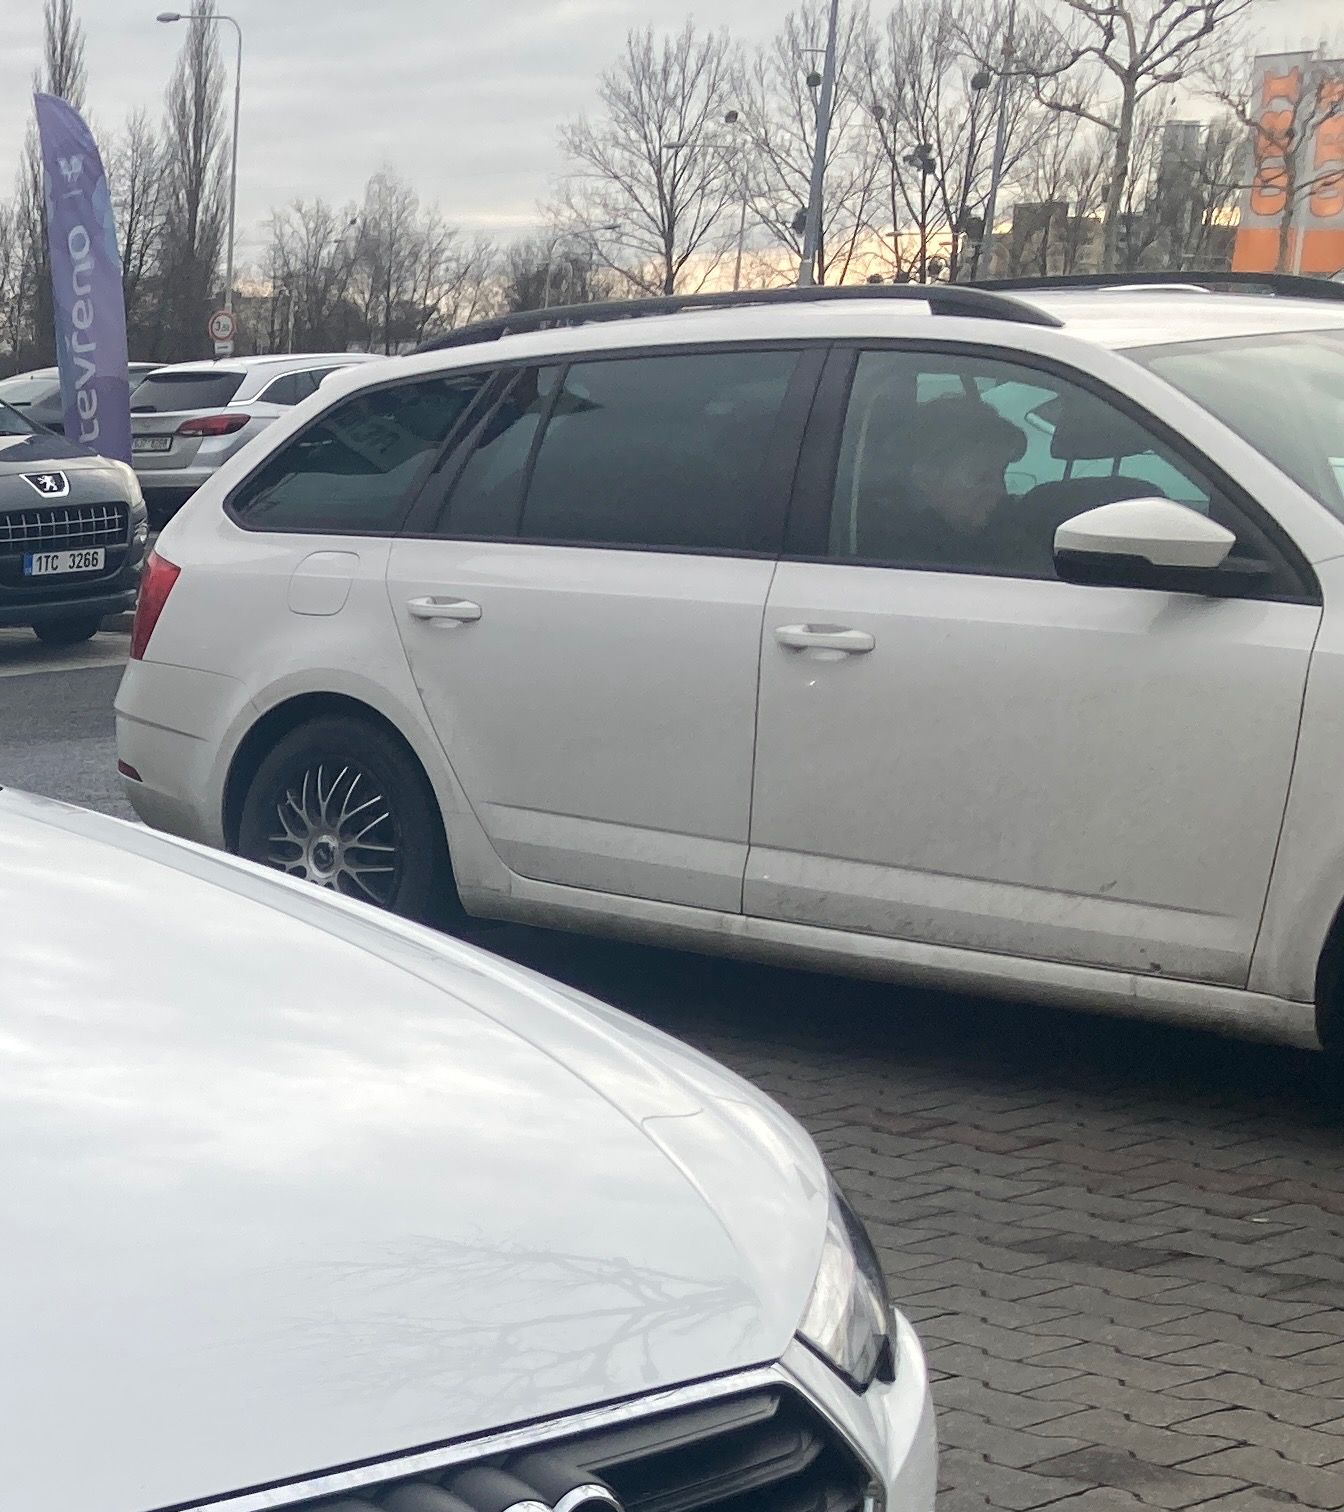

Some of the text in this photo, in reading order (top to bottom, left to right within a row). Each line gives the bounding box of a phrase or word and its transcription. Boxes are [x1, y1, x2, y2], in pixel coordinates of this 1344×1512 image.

[65, 224, 100, 448] tevřeno
[36, 554, 59, 573] 1TC
[68, 551, 99, 569] 3266
